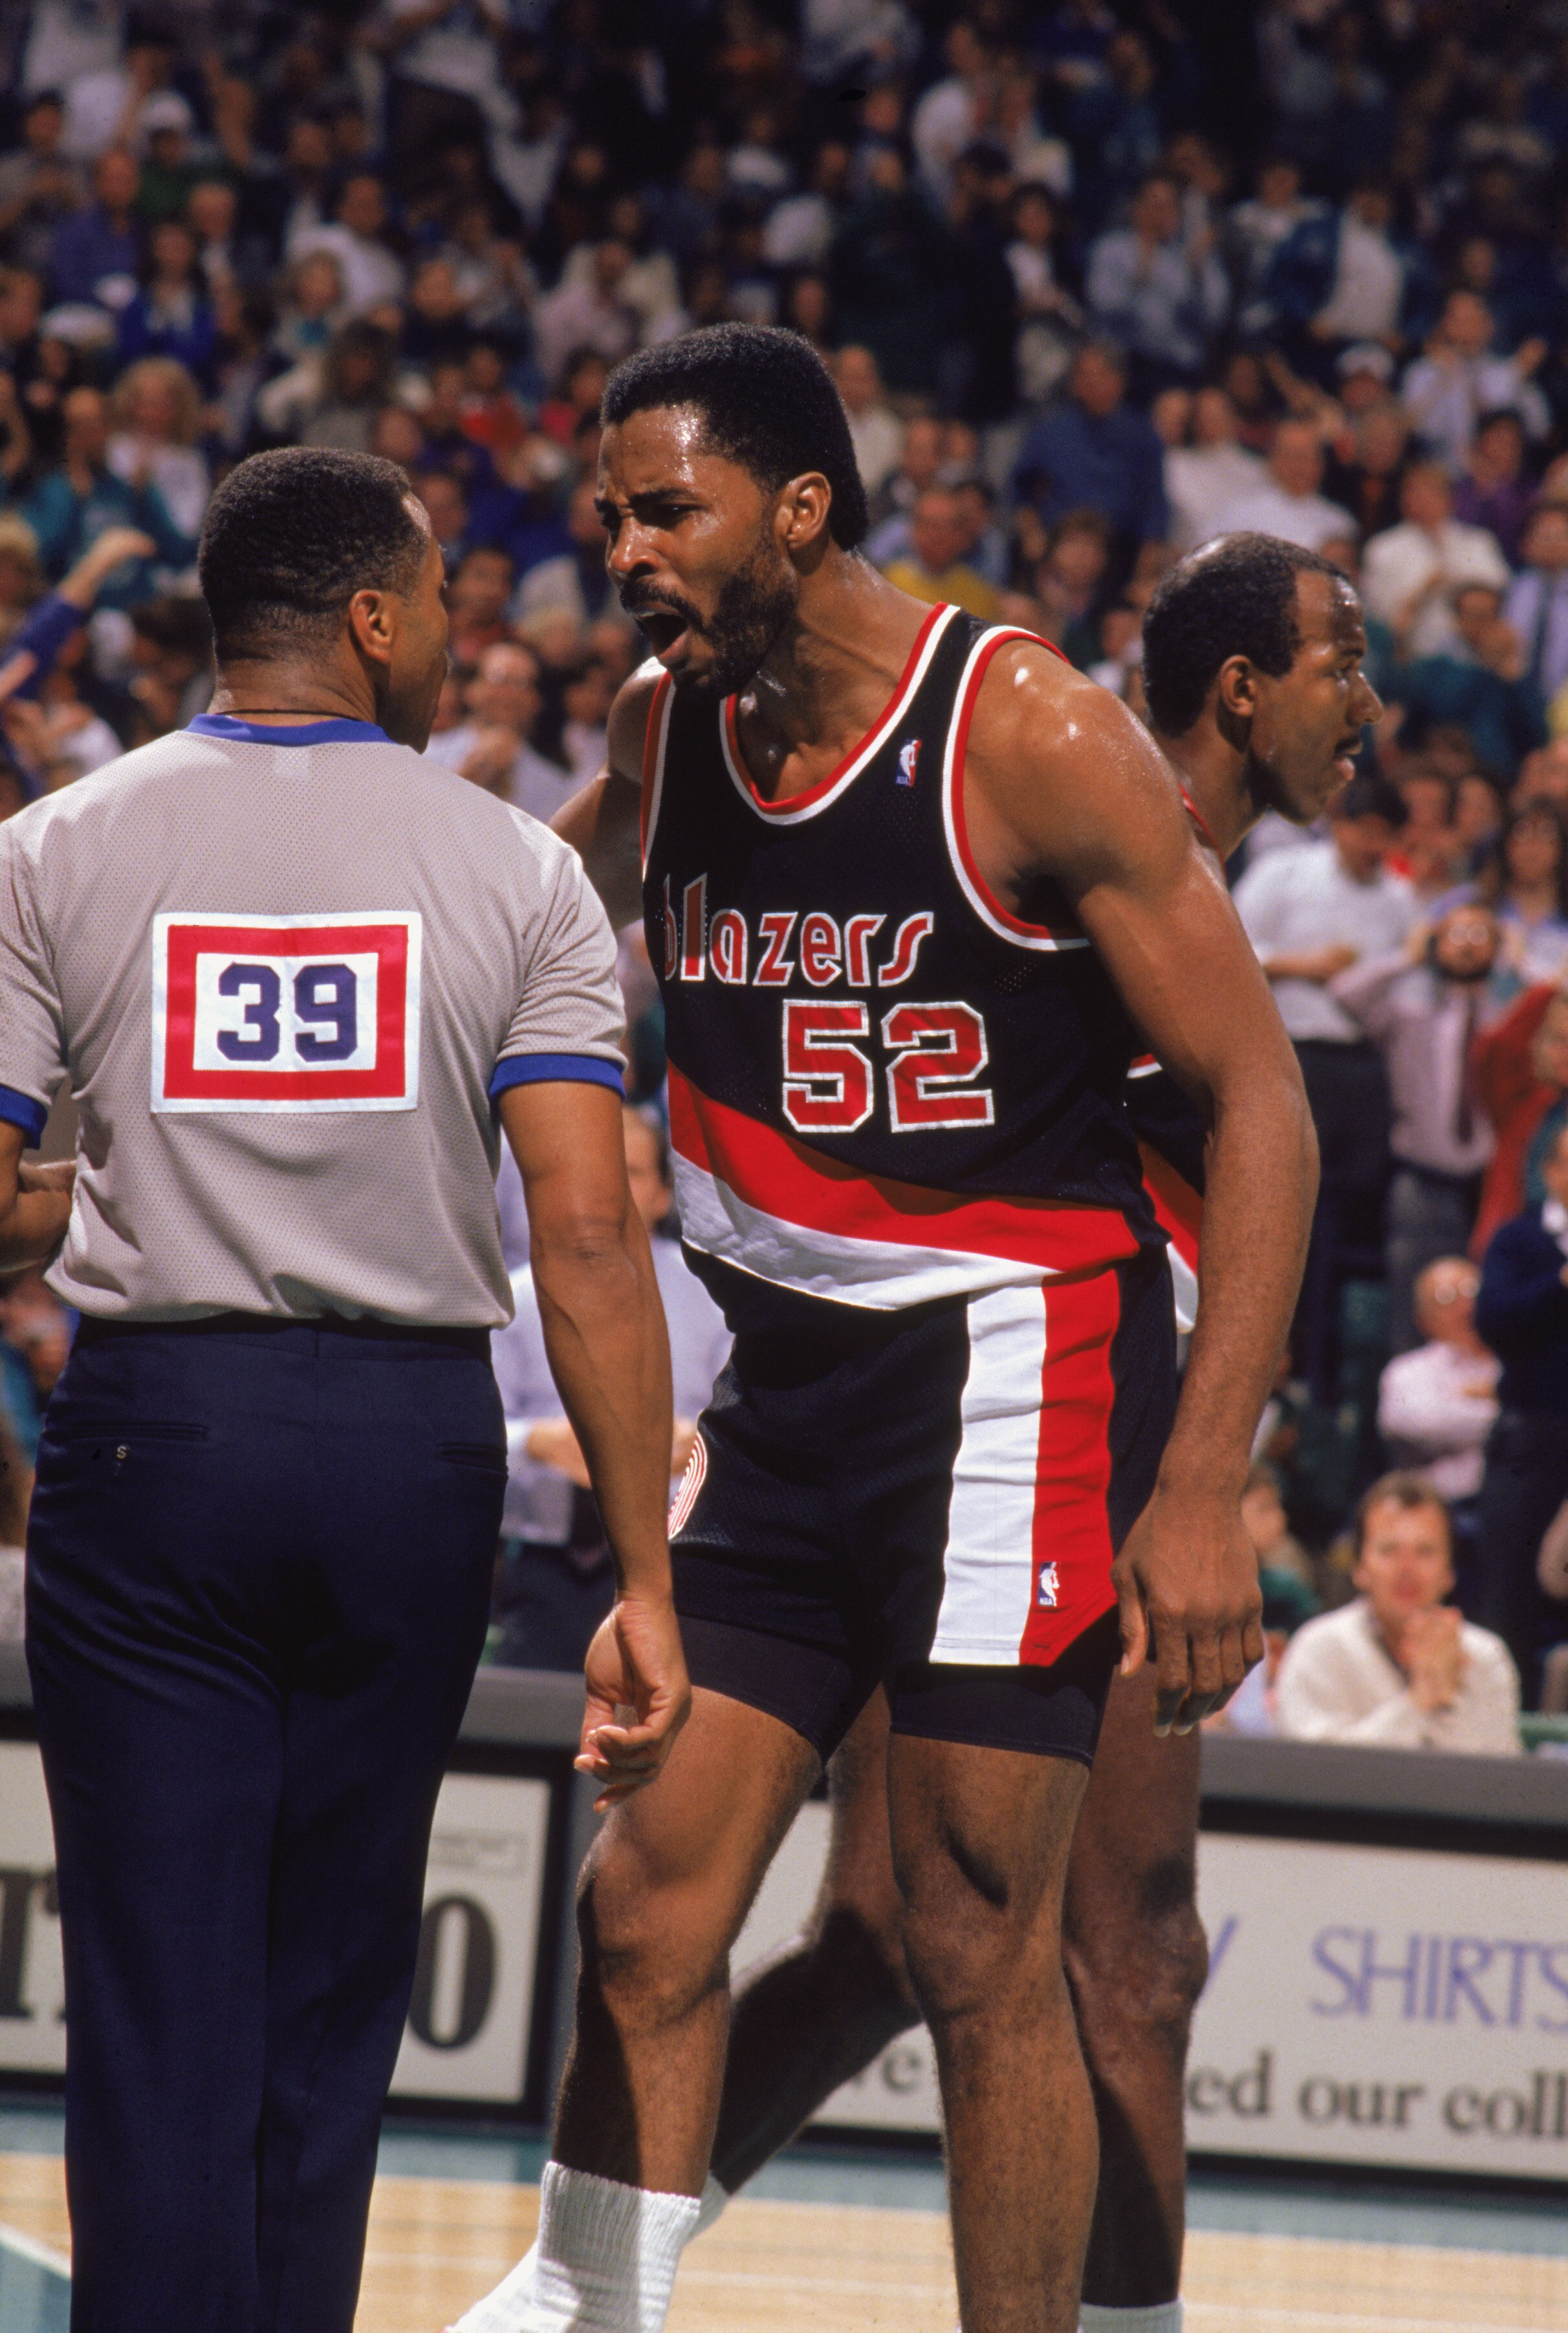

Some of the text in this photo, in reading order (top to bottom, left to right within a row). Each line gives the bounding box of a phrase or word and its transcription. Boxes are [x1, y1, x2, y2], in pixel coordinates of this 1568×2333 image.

[217, 961, 358, 1062] 39
[782, 999, 995, 1133] 52
[1296, 2074, 1426, 2129] our
